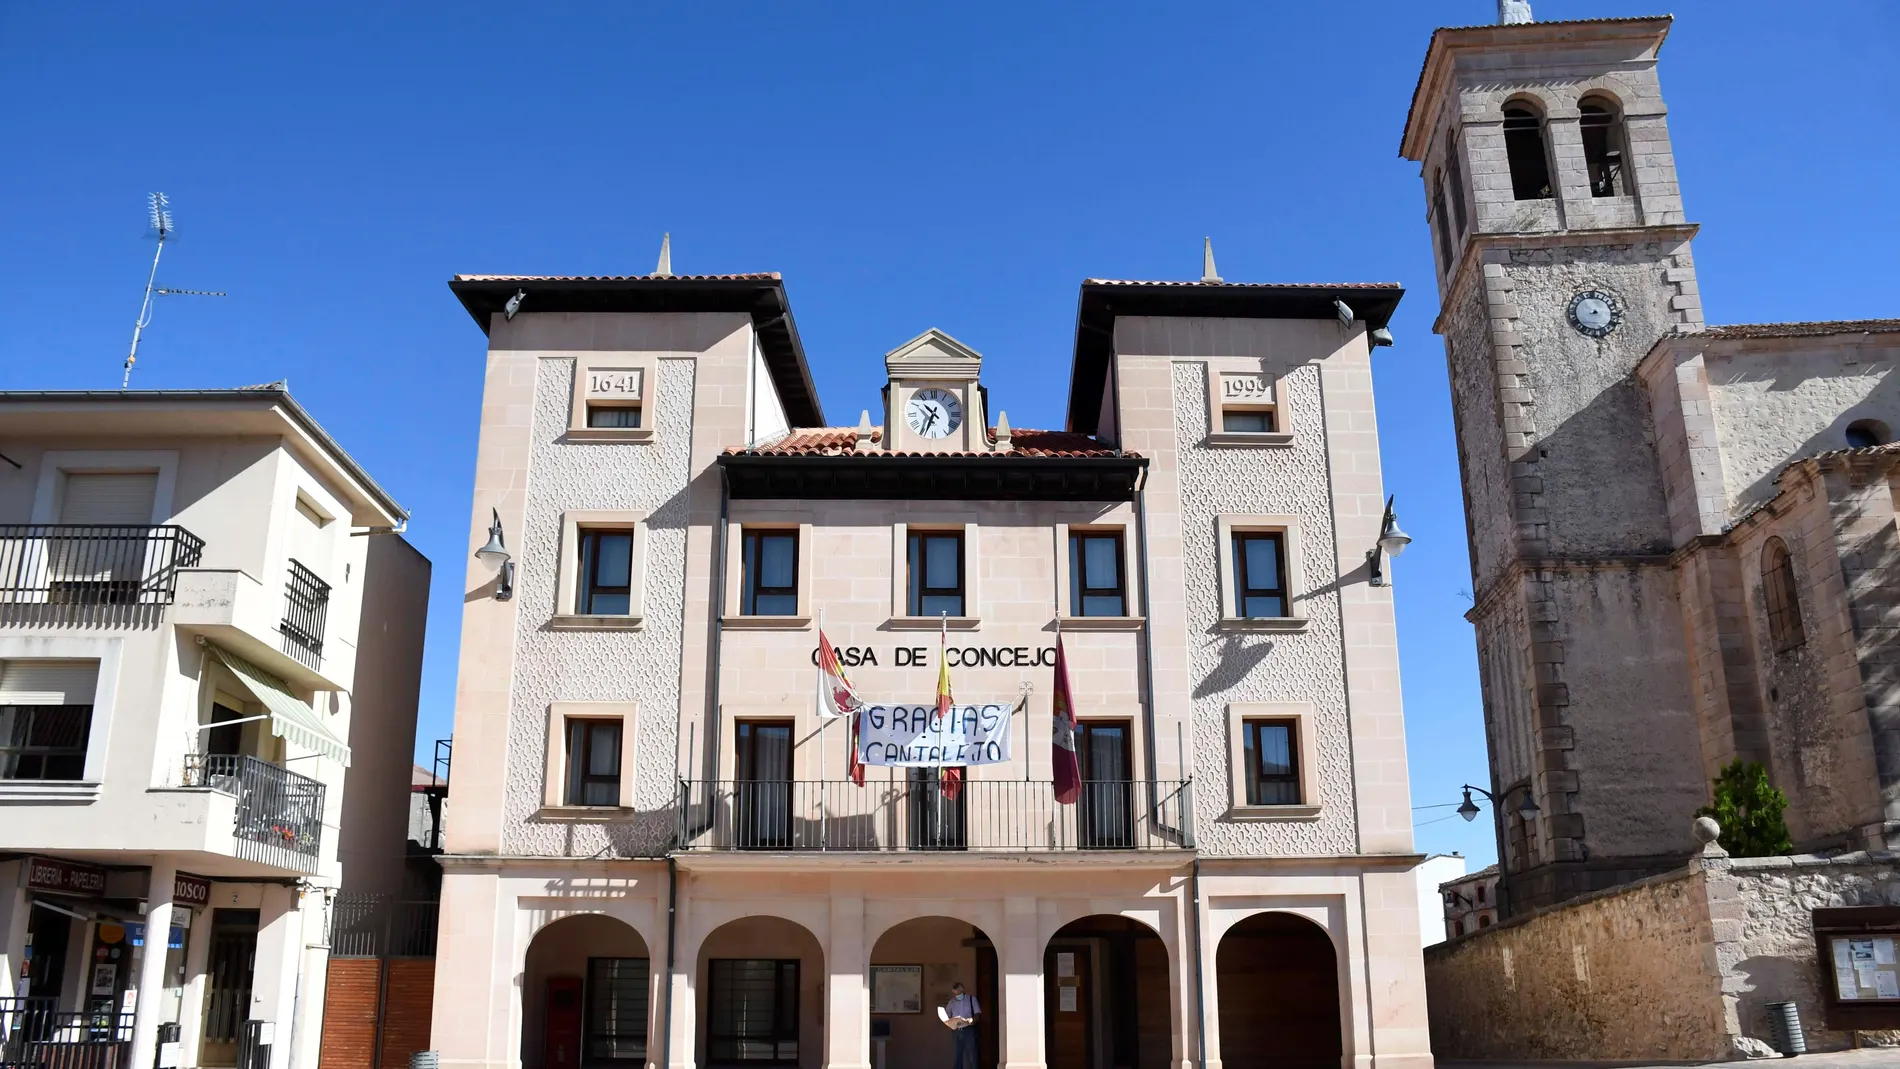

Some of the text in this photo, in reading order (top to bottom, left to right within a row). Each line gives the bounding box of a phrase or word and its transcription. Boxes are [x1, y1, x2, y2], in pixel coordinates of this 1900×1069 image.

[591, 375, 636, 393] 1641
[1224, 379, 1267, 397] 1999
[811, 647, 1057, 667] CASA DE CONCEJO
[868, 704, 1001, 736] GRACIAS
